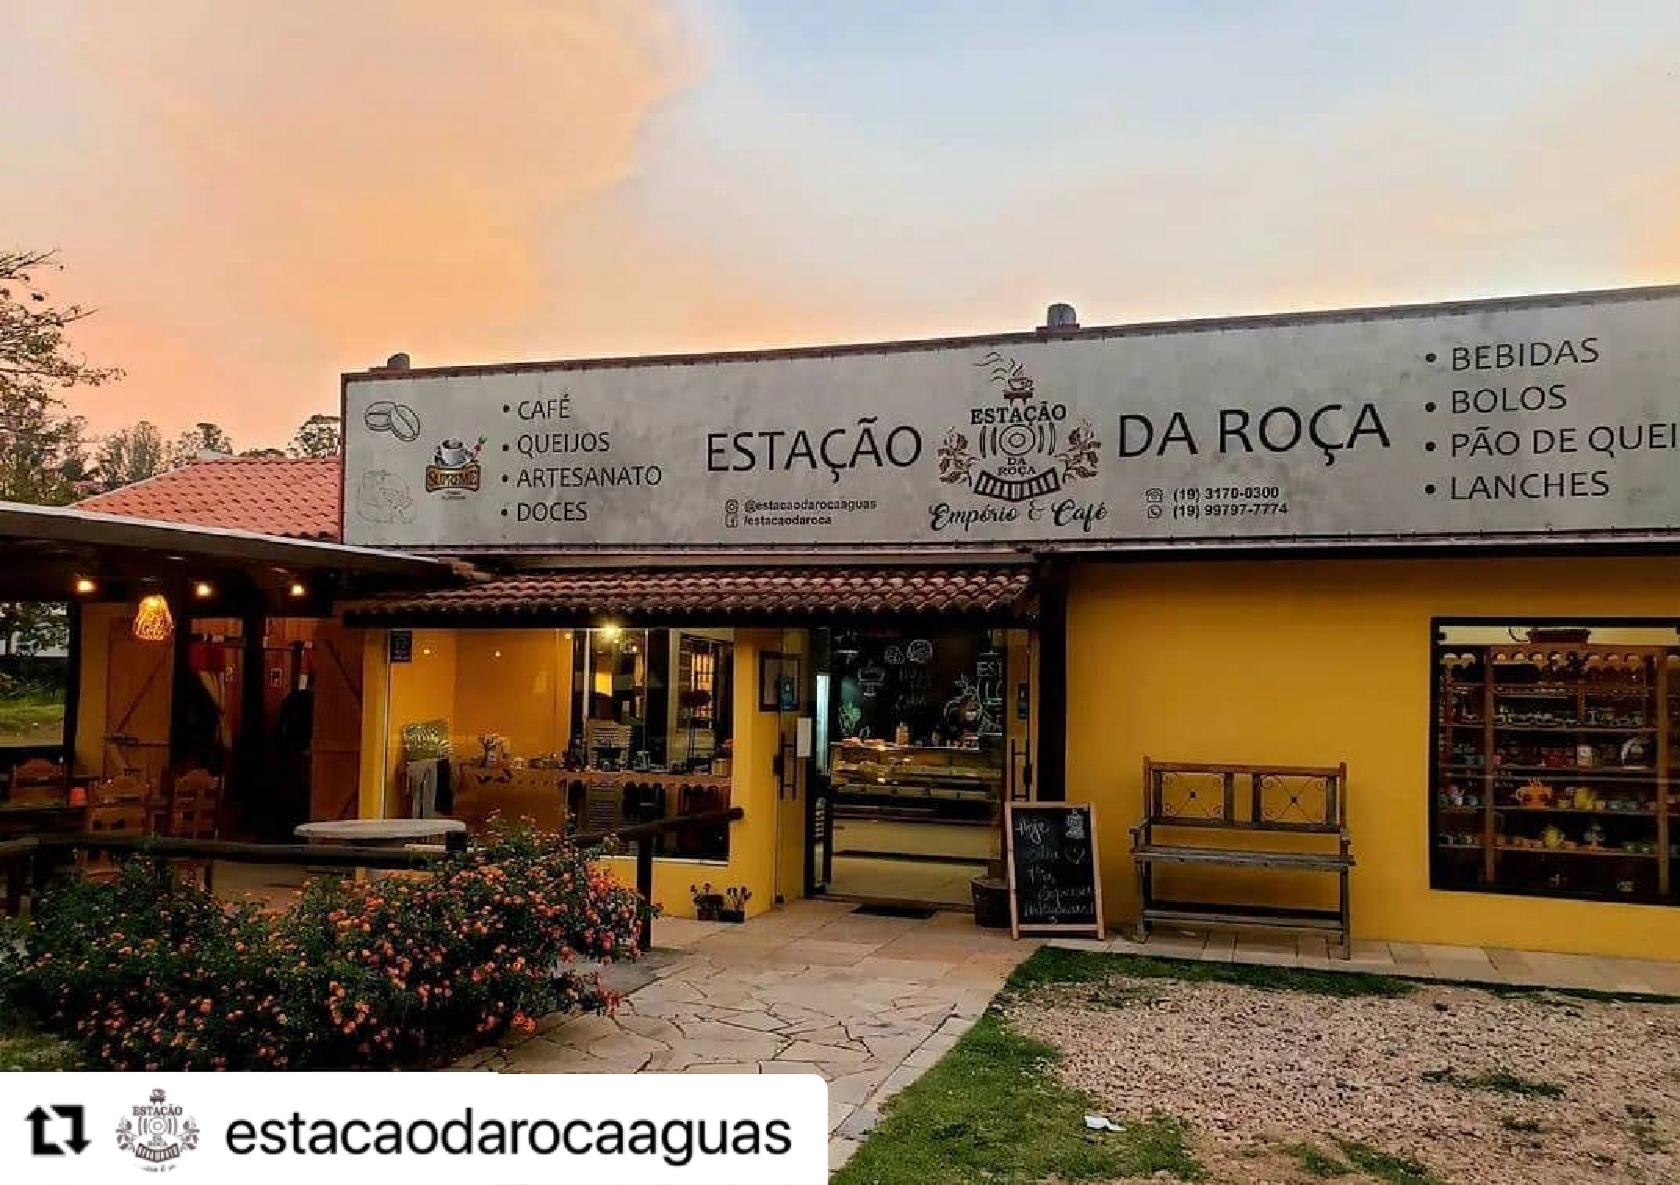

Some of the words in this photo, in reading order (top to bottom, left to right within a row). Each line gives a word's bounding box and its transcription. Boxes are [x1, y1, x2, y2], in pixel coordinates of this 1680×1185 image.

[1451, 337, 1600, 371] BEBIDAS
[517, 394, 571, 421] CAFÉ
[970, 400, 1067, 426] ESTAÇÃO
[1451, 384, 1568, 414] BOLOS
[517, 431, 611, 459] QUEIJOS
[706, 415, 923, 483] ESTAÇÃO
[1118, 411, 1198, 458] DA
[1218, 403, 1391, 466] ROÇA
[1450, 426, 1520, 458] PÃO
[1532, 428, 1578, 455] DE
[516, 465, 662, 488] ARTESANATO
[1450, 470, 1610, 500] LANCHES
[1173, 487, 1200, 502] (19)
[1205, 486, 1279, 500] 3170-0300
[517, 501, 588, 521] DOCES
[930, 502, 1017, 532] Empório
[1051, 499, 1107, 532] Café
[1173, 505, 1200, 520] (19)
[1204, 502, 1289, 516] 99797-7774
